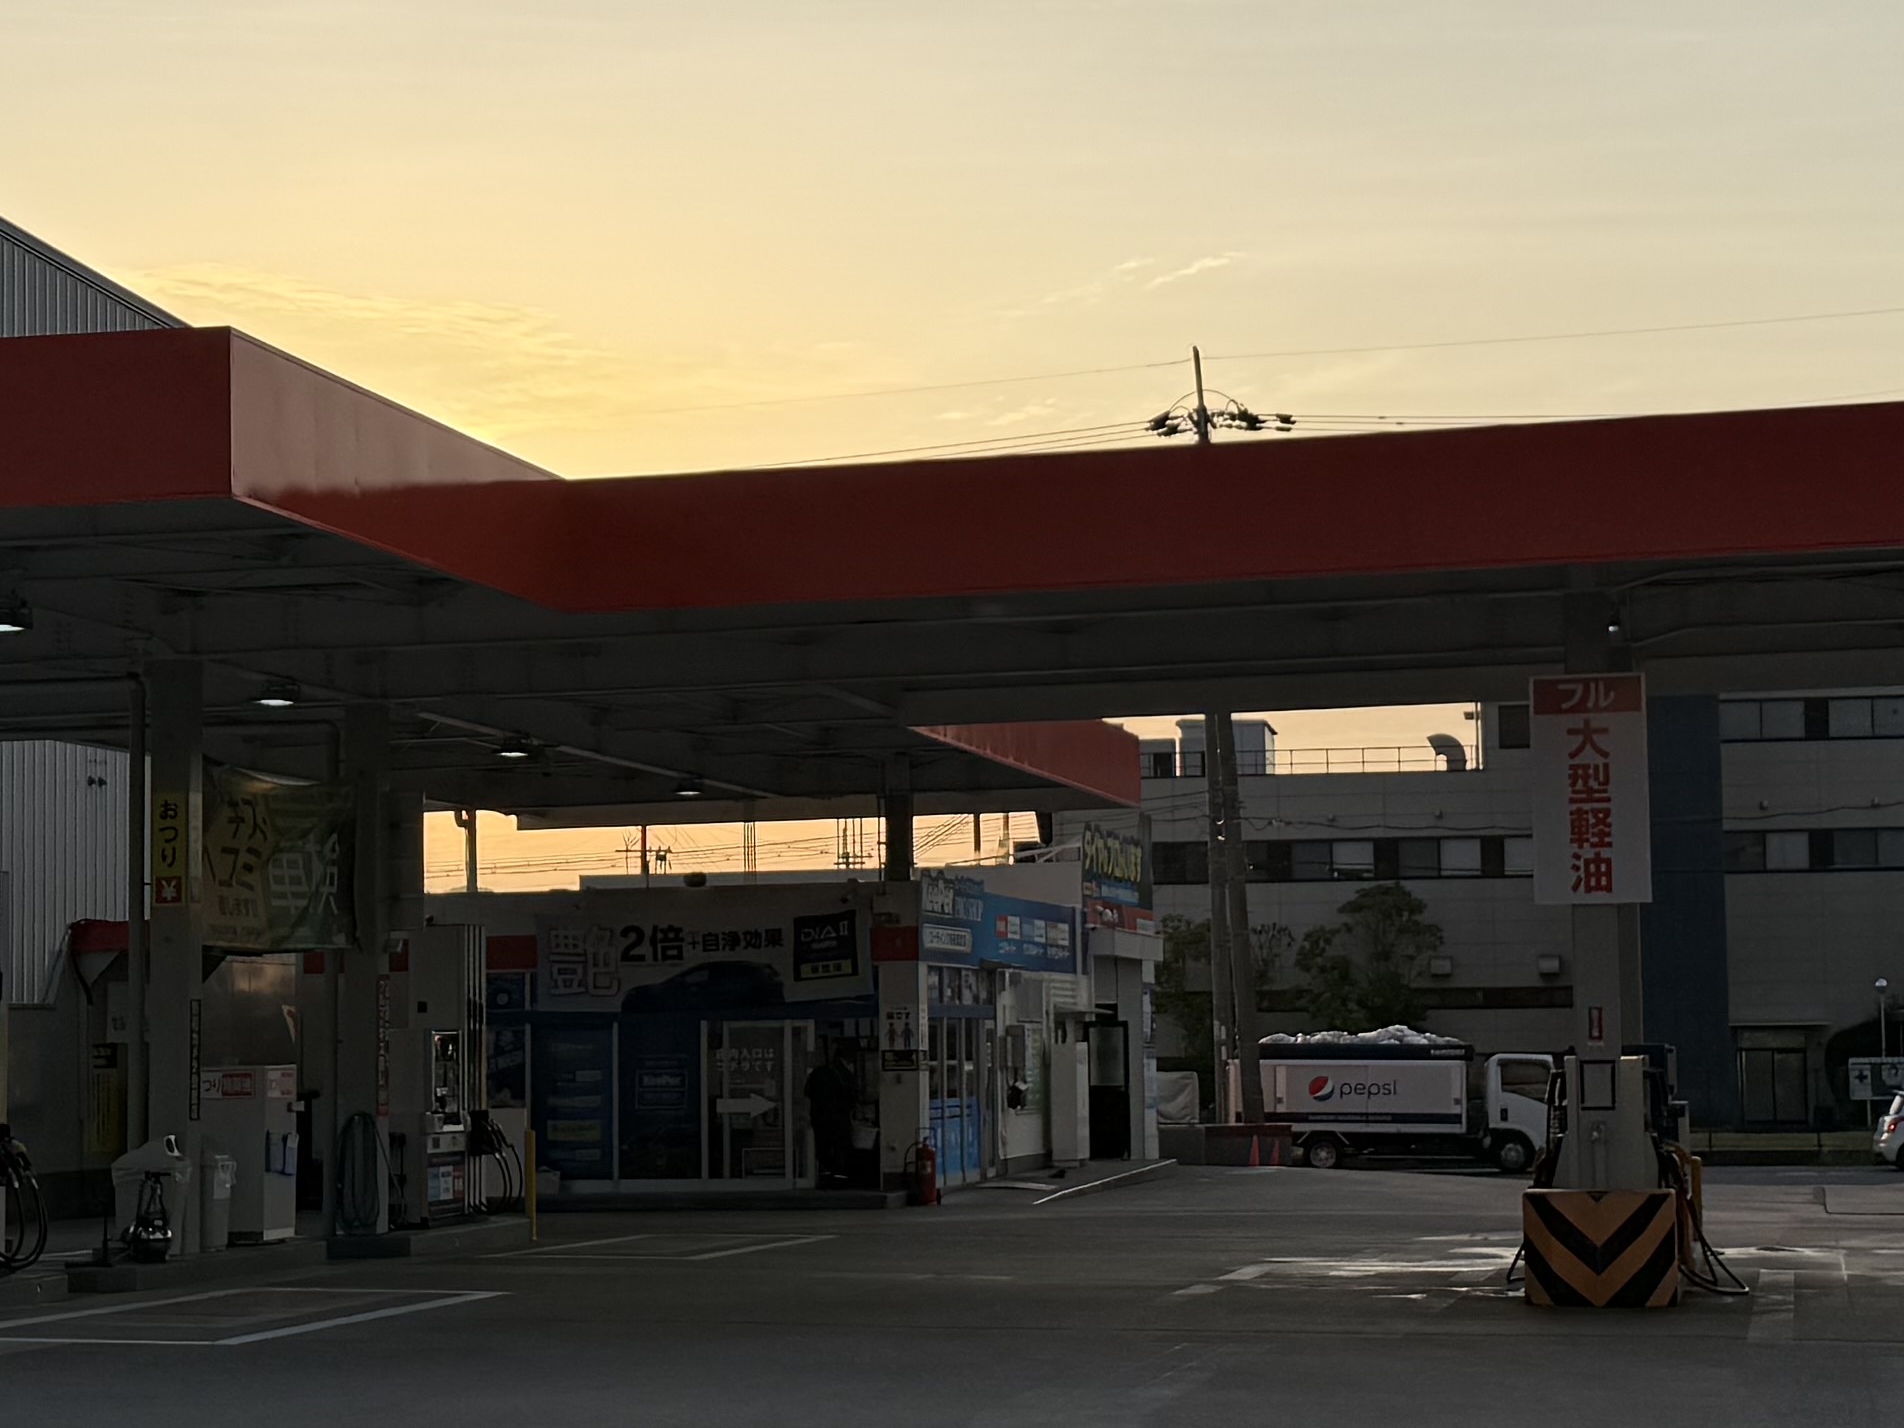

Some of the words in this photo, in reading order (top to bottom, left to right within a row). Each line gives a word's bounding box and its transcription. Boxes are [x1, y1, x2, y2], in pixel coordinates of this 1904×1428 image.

[1555, 681, 1616, 710] フル
[1566, 719, 1614, 895] 大型軽油
[159, 800, 179, 869] おつり
[160, 878, 177, 902] ¥
[620, 925, 685, 963] 2倍
[1340, 1080, 1397, 1100] pepsi
